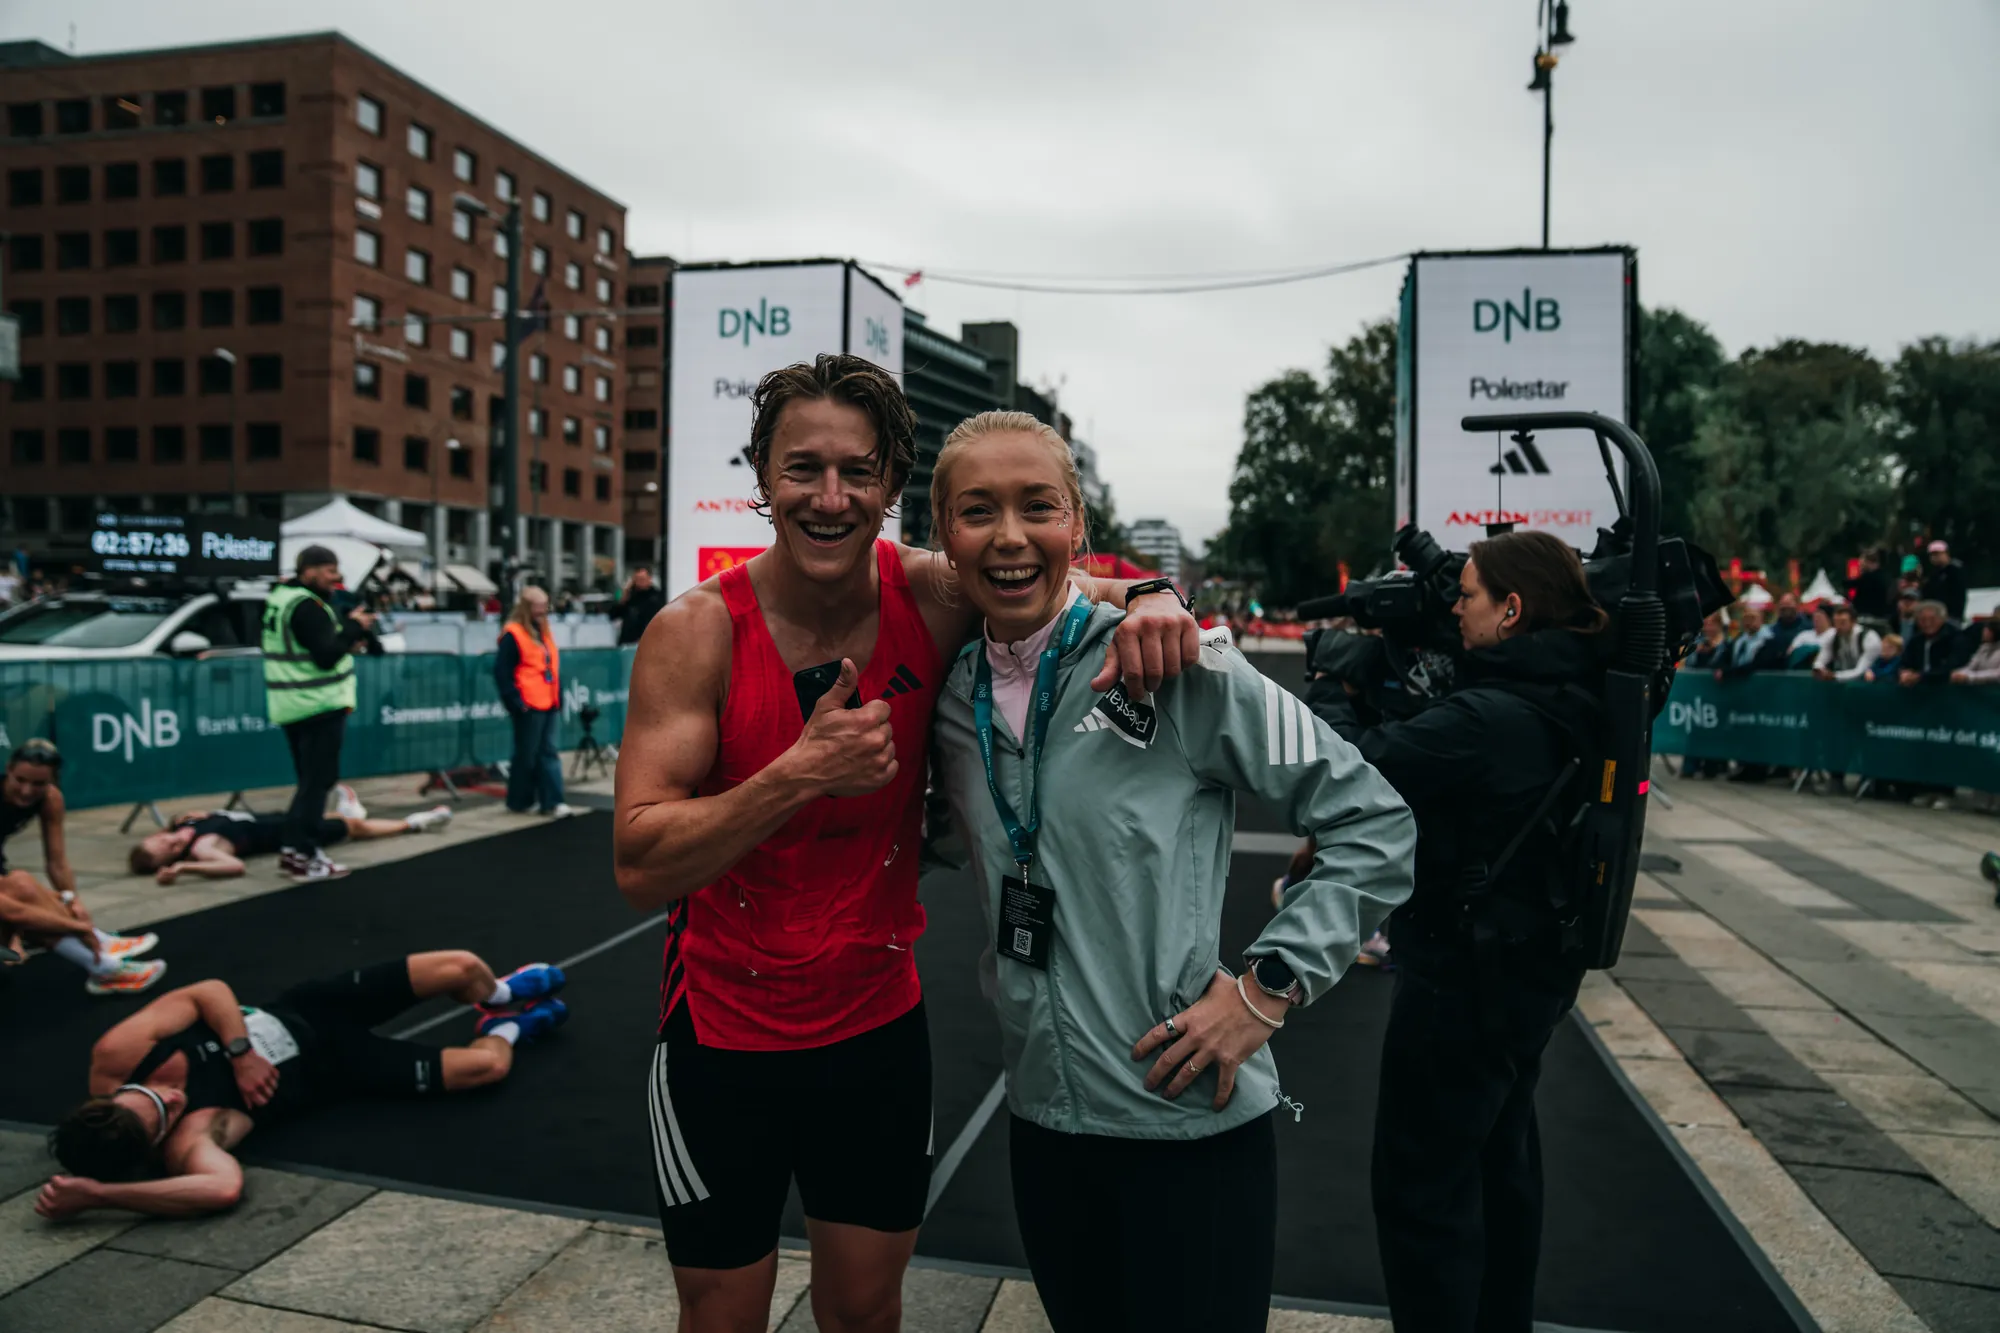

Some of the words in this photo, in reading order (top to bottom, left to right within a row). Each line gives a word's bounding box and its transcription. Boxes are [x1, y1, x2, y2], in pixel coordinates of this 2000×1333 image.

[719, 297, 791, 346] DNB
[1473, 285, 1561, 343] DNB
[714, 377, 758, 399] Pole
[1470, 376, 1570, 401] Polestar
[694, 499, 757, 514] ANTO
[202, 531, 276, 561] Polestar
[1067, 618, 1080, 645] Sammen
[563, 676, 589, 723] NB
[978, 683, 987, 698] DNB
[1040, 692, 1051, 711] DNB
[93, 697, 180, 763] DNB
[1669, 697, 1718, 734] DNB
[981, 727, 990, 757] Sammen
